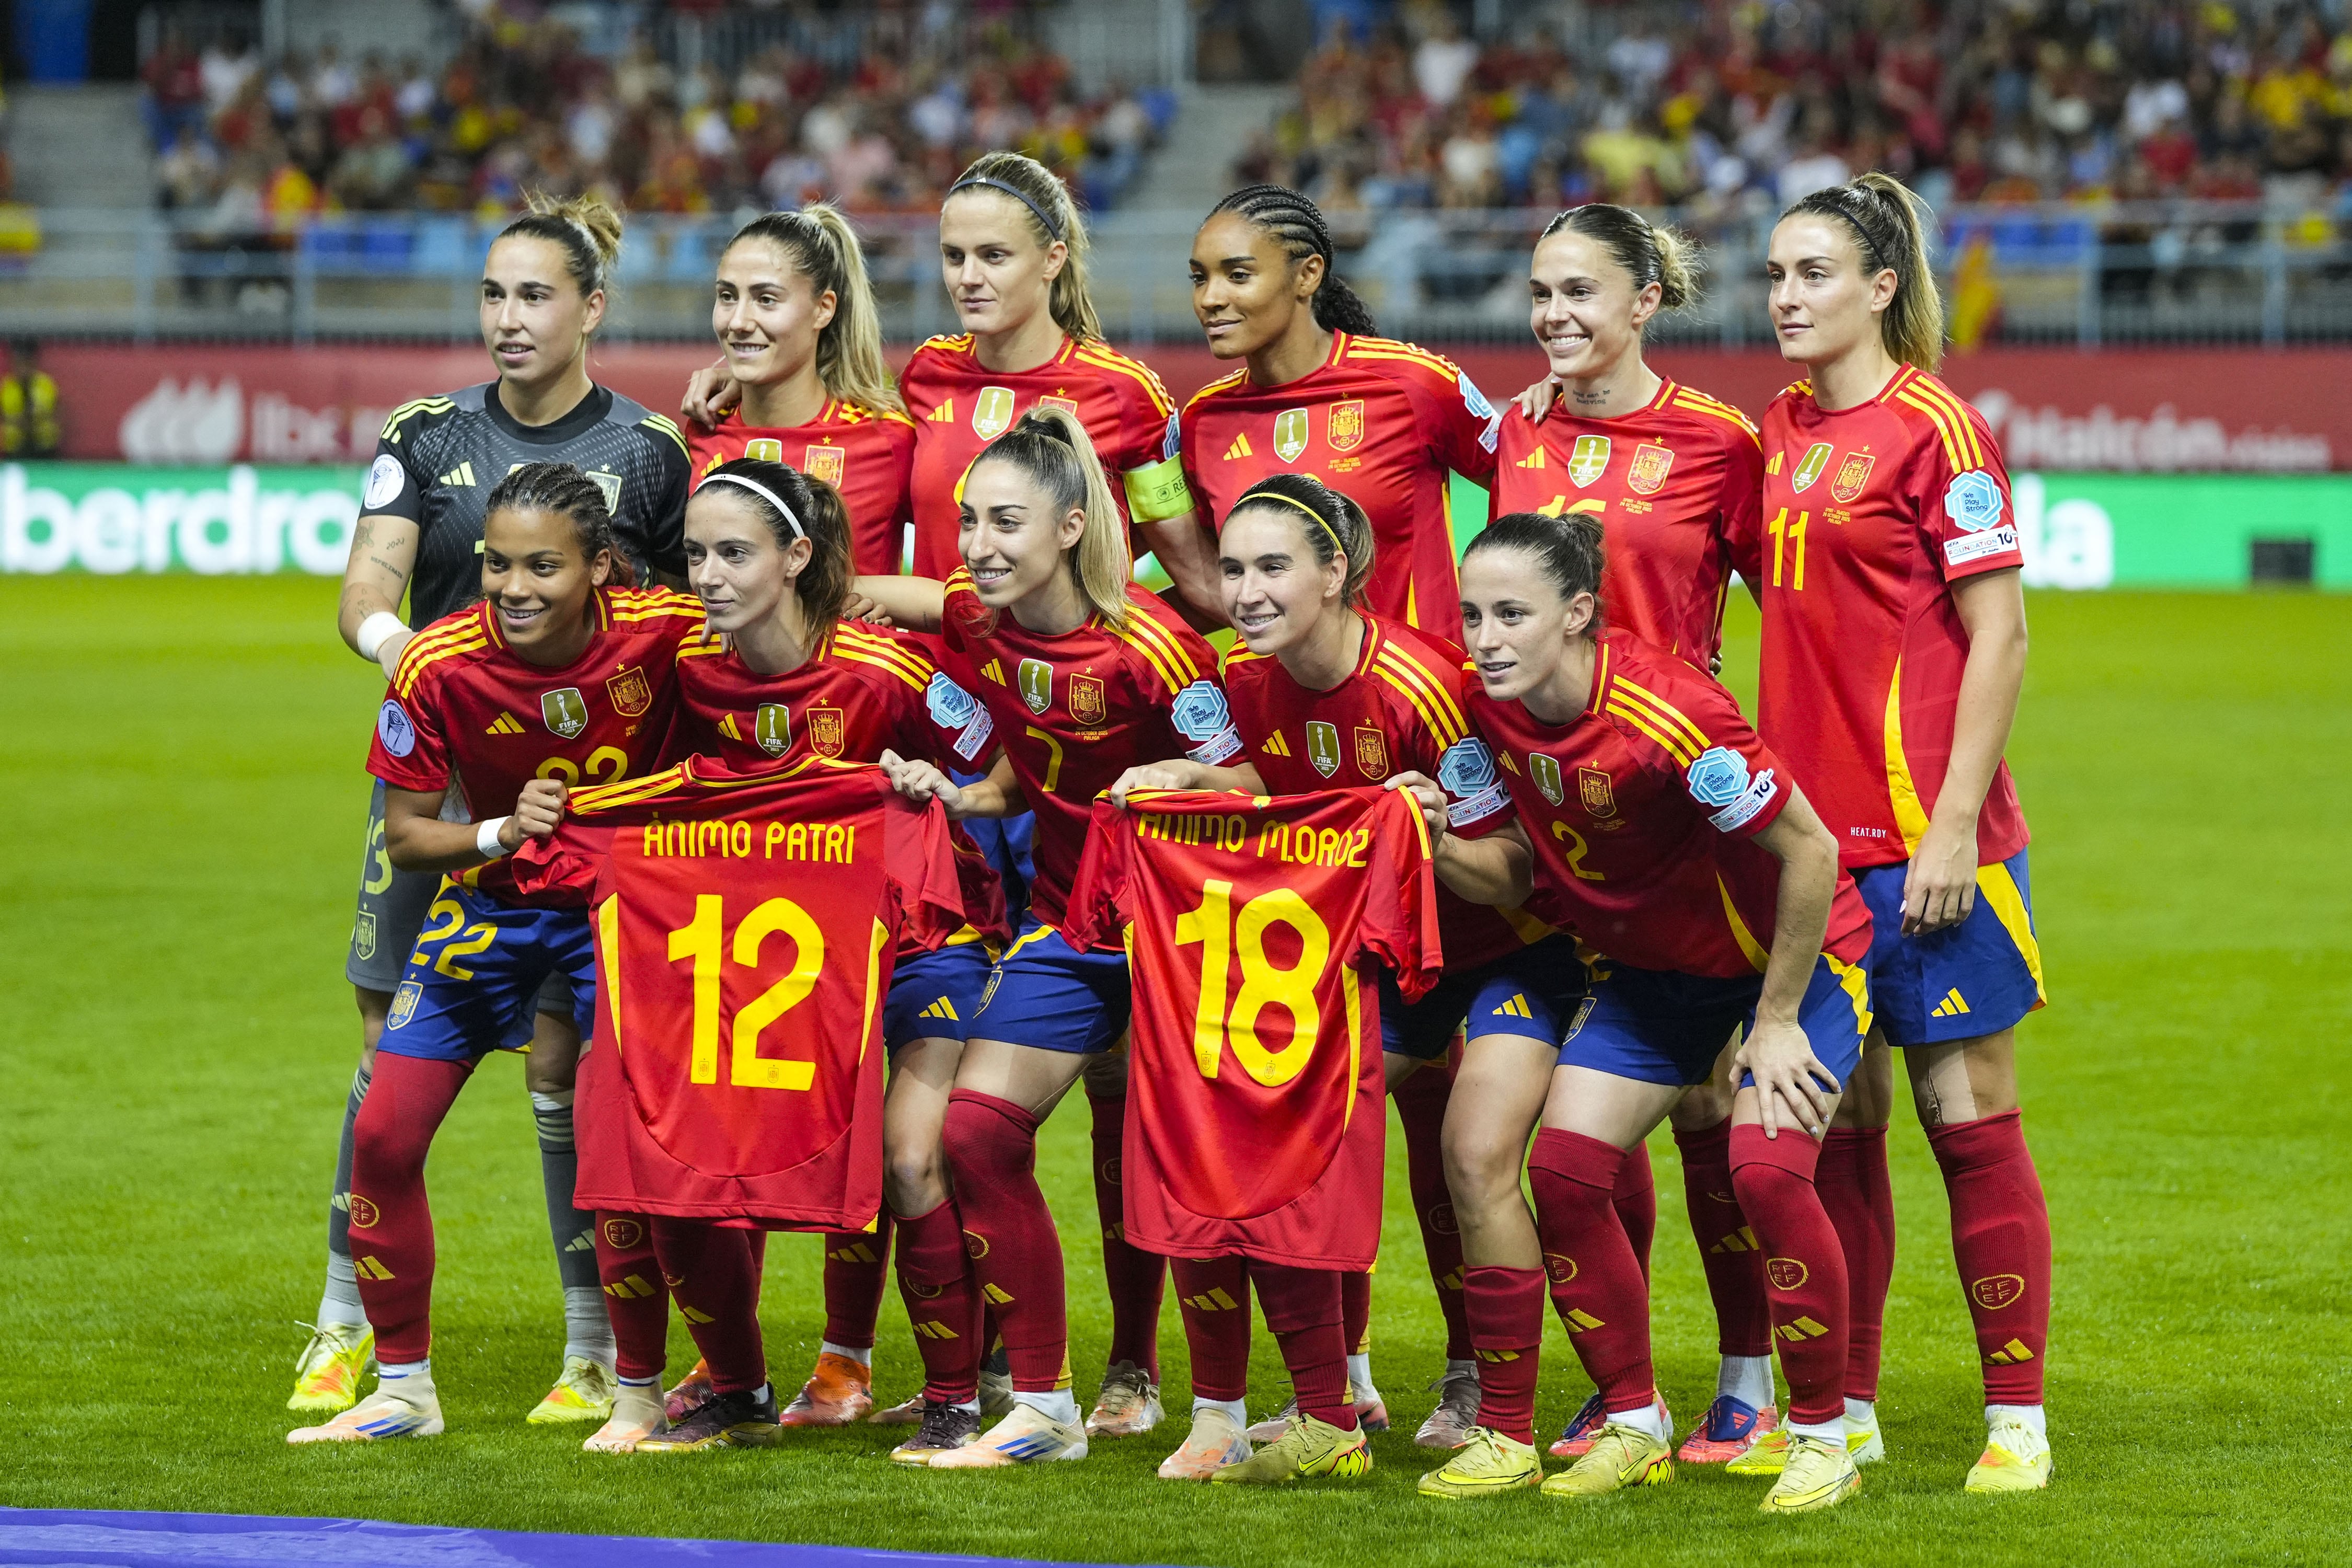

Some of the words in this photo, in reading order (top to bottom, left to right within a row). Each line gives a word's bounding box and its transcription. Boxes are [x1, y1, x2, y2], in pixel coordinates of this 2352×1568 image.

[1769, 507, 1809, 591] 11
[1949, 538, 1997, 556] FOUNDATION
[941, 695, 949, 704] We
[946, 696, 956, 708] Play
[951, 694, 963, 712] Strong
[1028, 693, 1042, 703] FIFA
[1191, 709, 1206, 719] Play
[1194, 710, 1216, 725] Strong
[559, 720, 578, 729] FIFA
[956, 739, 965, 749] UEFA
[962, 716, 988, 755] FOUNDATION
[1026, 725, 1063, 792] 7
[1458, 765, 1473, 775] Play
[1461, 766, 1482, 780] Strong
[1709, 775, 1723, 787] Play
[1714, 774, 1734, 791] Strong
[1542, 787, 1555, 796] FIFA
[1449, 796, 1496, 819] FOUNDATION
[1715, 798, 1756, 826] FOUNDATION
[1850, 827, 1886, 838] HEAT.RDY
[765, 821, 855, 864] PATRI
[1552, 821, 1605, 880] 2
[410, 900, 498, 981] 22
[1175, 879, 1330, 1087] 18
[668, 894, 825, 1091] 12
